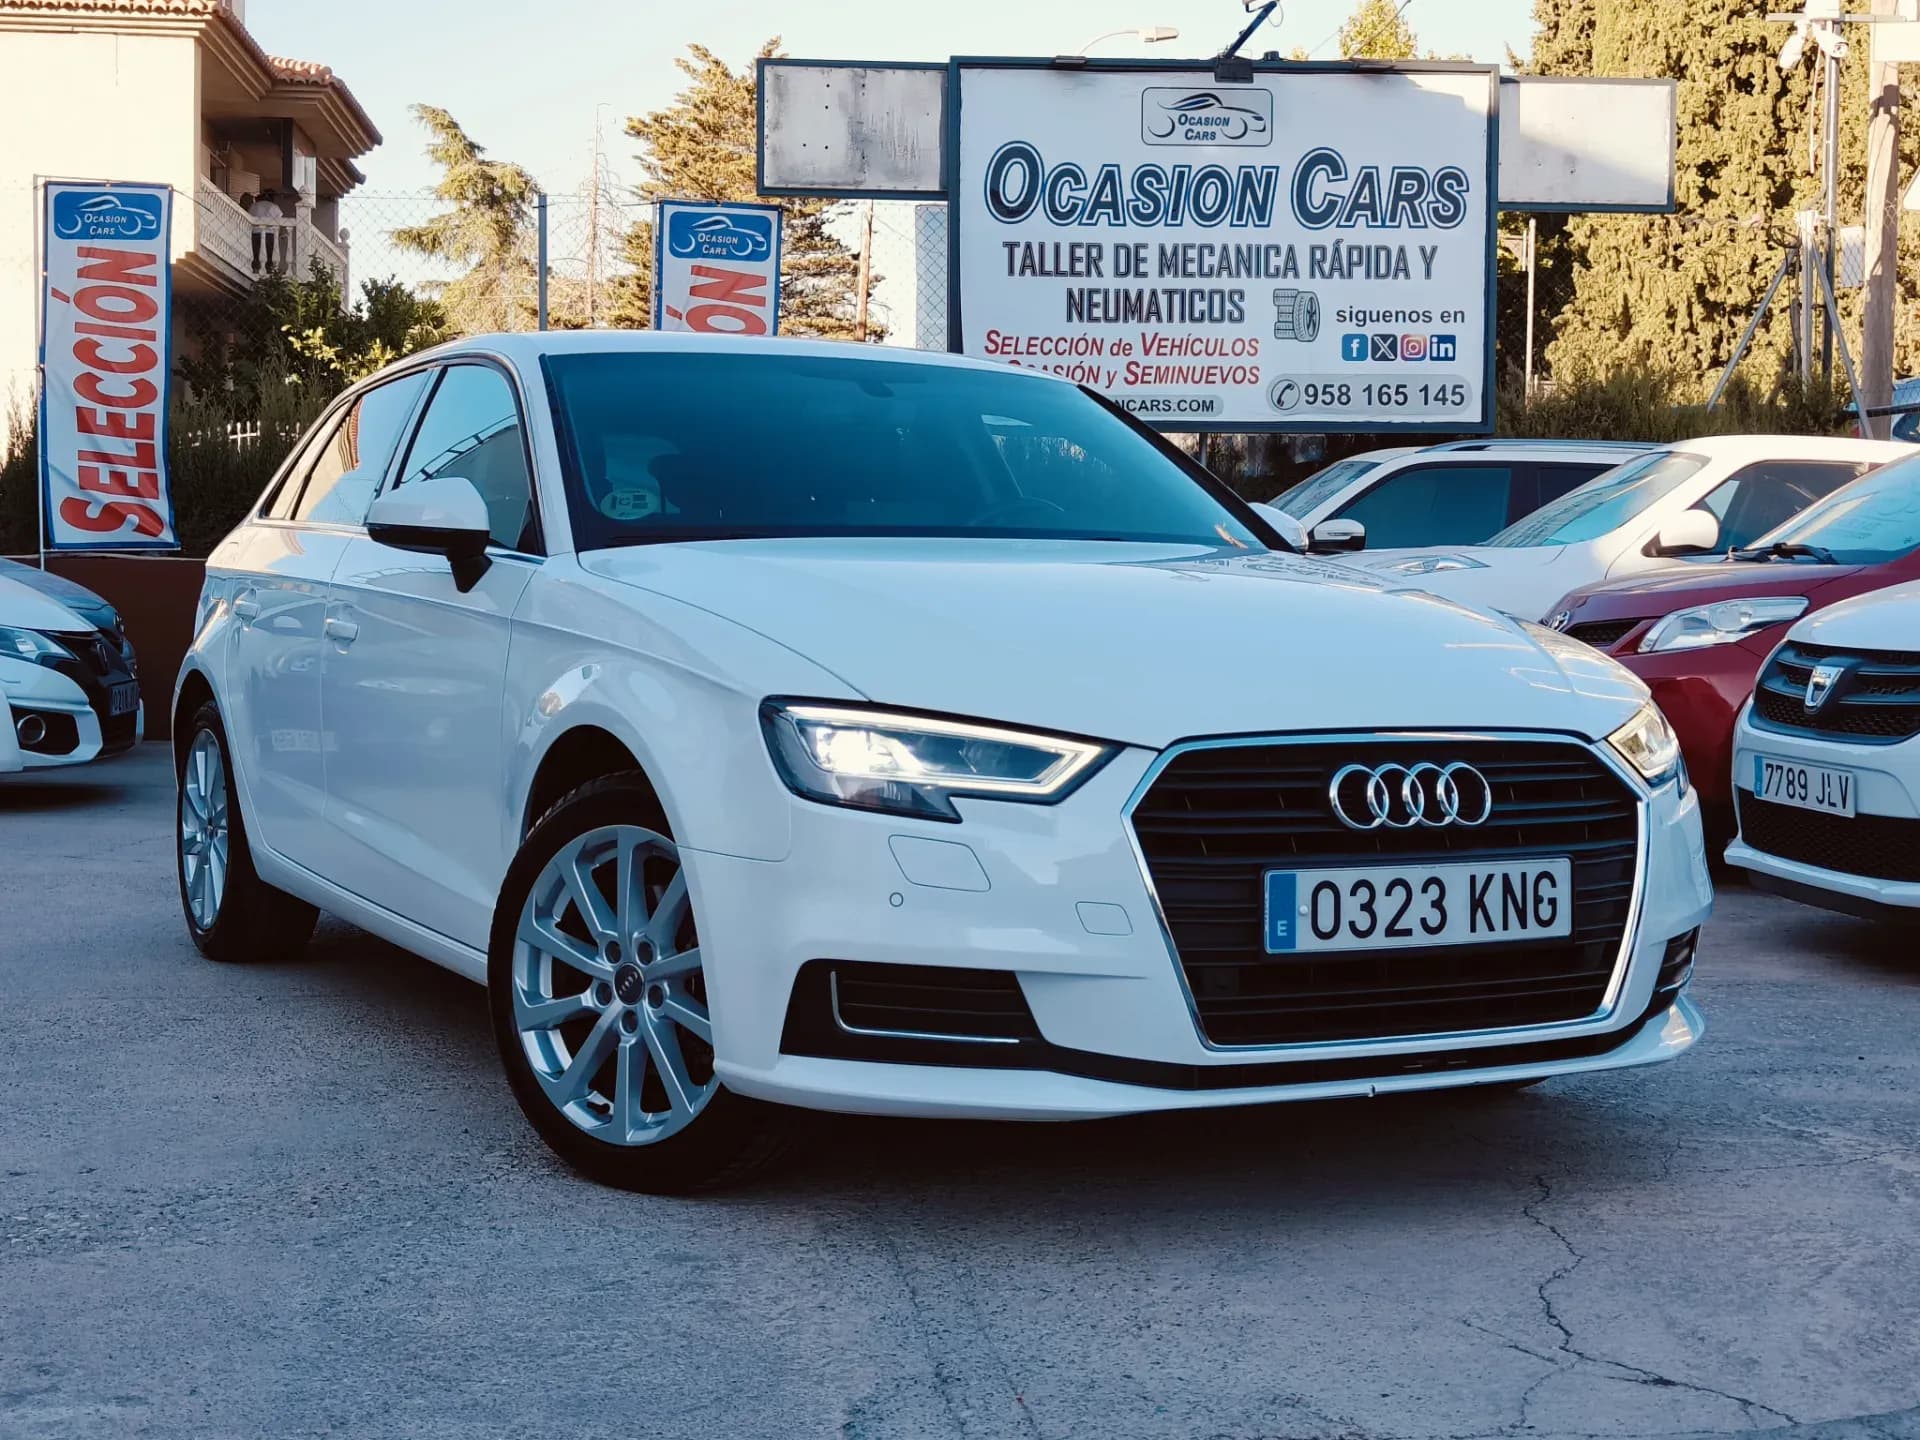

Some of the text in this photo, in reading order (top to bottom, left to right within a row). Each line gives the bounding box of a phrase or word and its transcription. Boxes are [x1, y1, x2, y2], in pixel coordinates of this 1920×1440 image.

[1178, 113, 1230, 126] OCASION
[1184, 128, 1216, 140] CARS
[984, 140, 1469, 230] OCASION CARS
[84, 213, 127, 223] OCASION
[89, 225, 115, 235] CARS
[697, 232, 738, 245] OCASION
[702, 244, 727, 255] CARS
[1002, 238, 1438, 280] TALLER DE MECANICA RÁPIDA Y
[1065, 288, 1245, 324] NEUMATICOS
[1440, 310, 1466, 323] en
[984, 330, 1259, 357] SELECCIÓN de VEHÍCULOS
[1105, 370, 1118, 389] y
[1124, 361, 1260, 386] SEMINUEVOS
[51, 246, 164, 537] SELECCIÓN
[1304, 384, 1465, 406] 958 165 145
[1765, 763, 1849, 809] 7789 JLV
[1311, 876, 1448, 940] 0323
[1469, 870, 1558, 933] KNG
[1277, 920, 1288, 936] E
